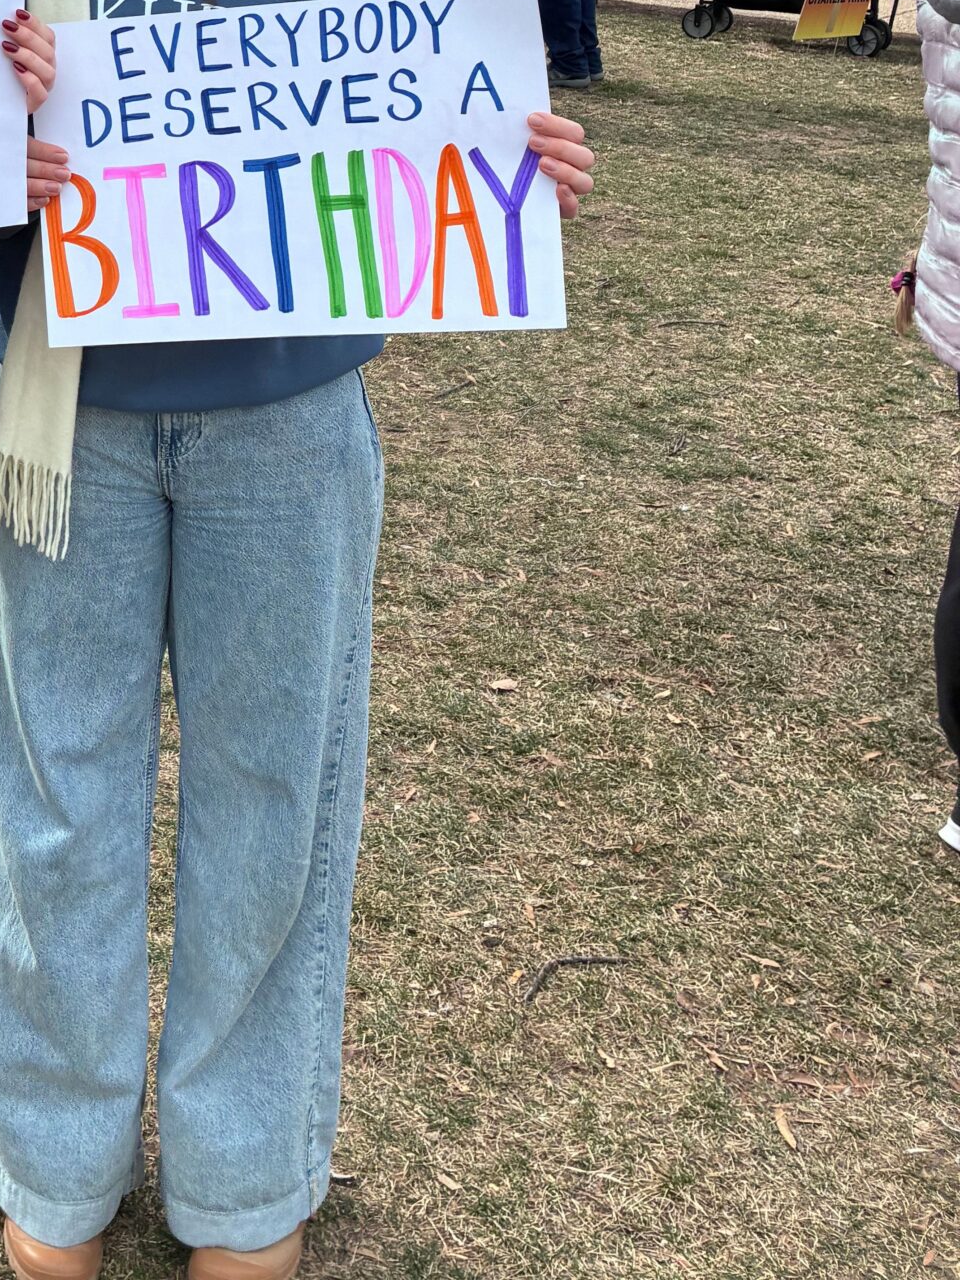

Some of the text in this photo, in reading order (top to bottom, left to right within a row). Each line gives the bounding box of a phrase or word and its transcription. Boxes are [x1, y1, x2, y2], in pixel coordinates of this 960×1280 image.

[82, 61, 505, 148] DESERVES A
[44, 142, 541, 320] BIRTHDAY
